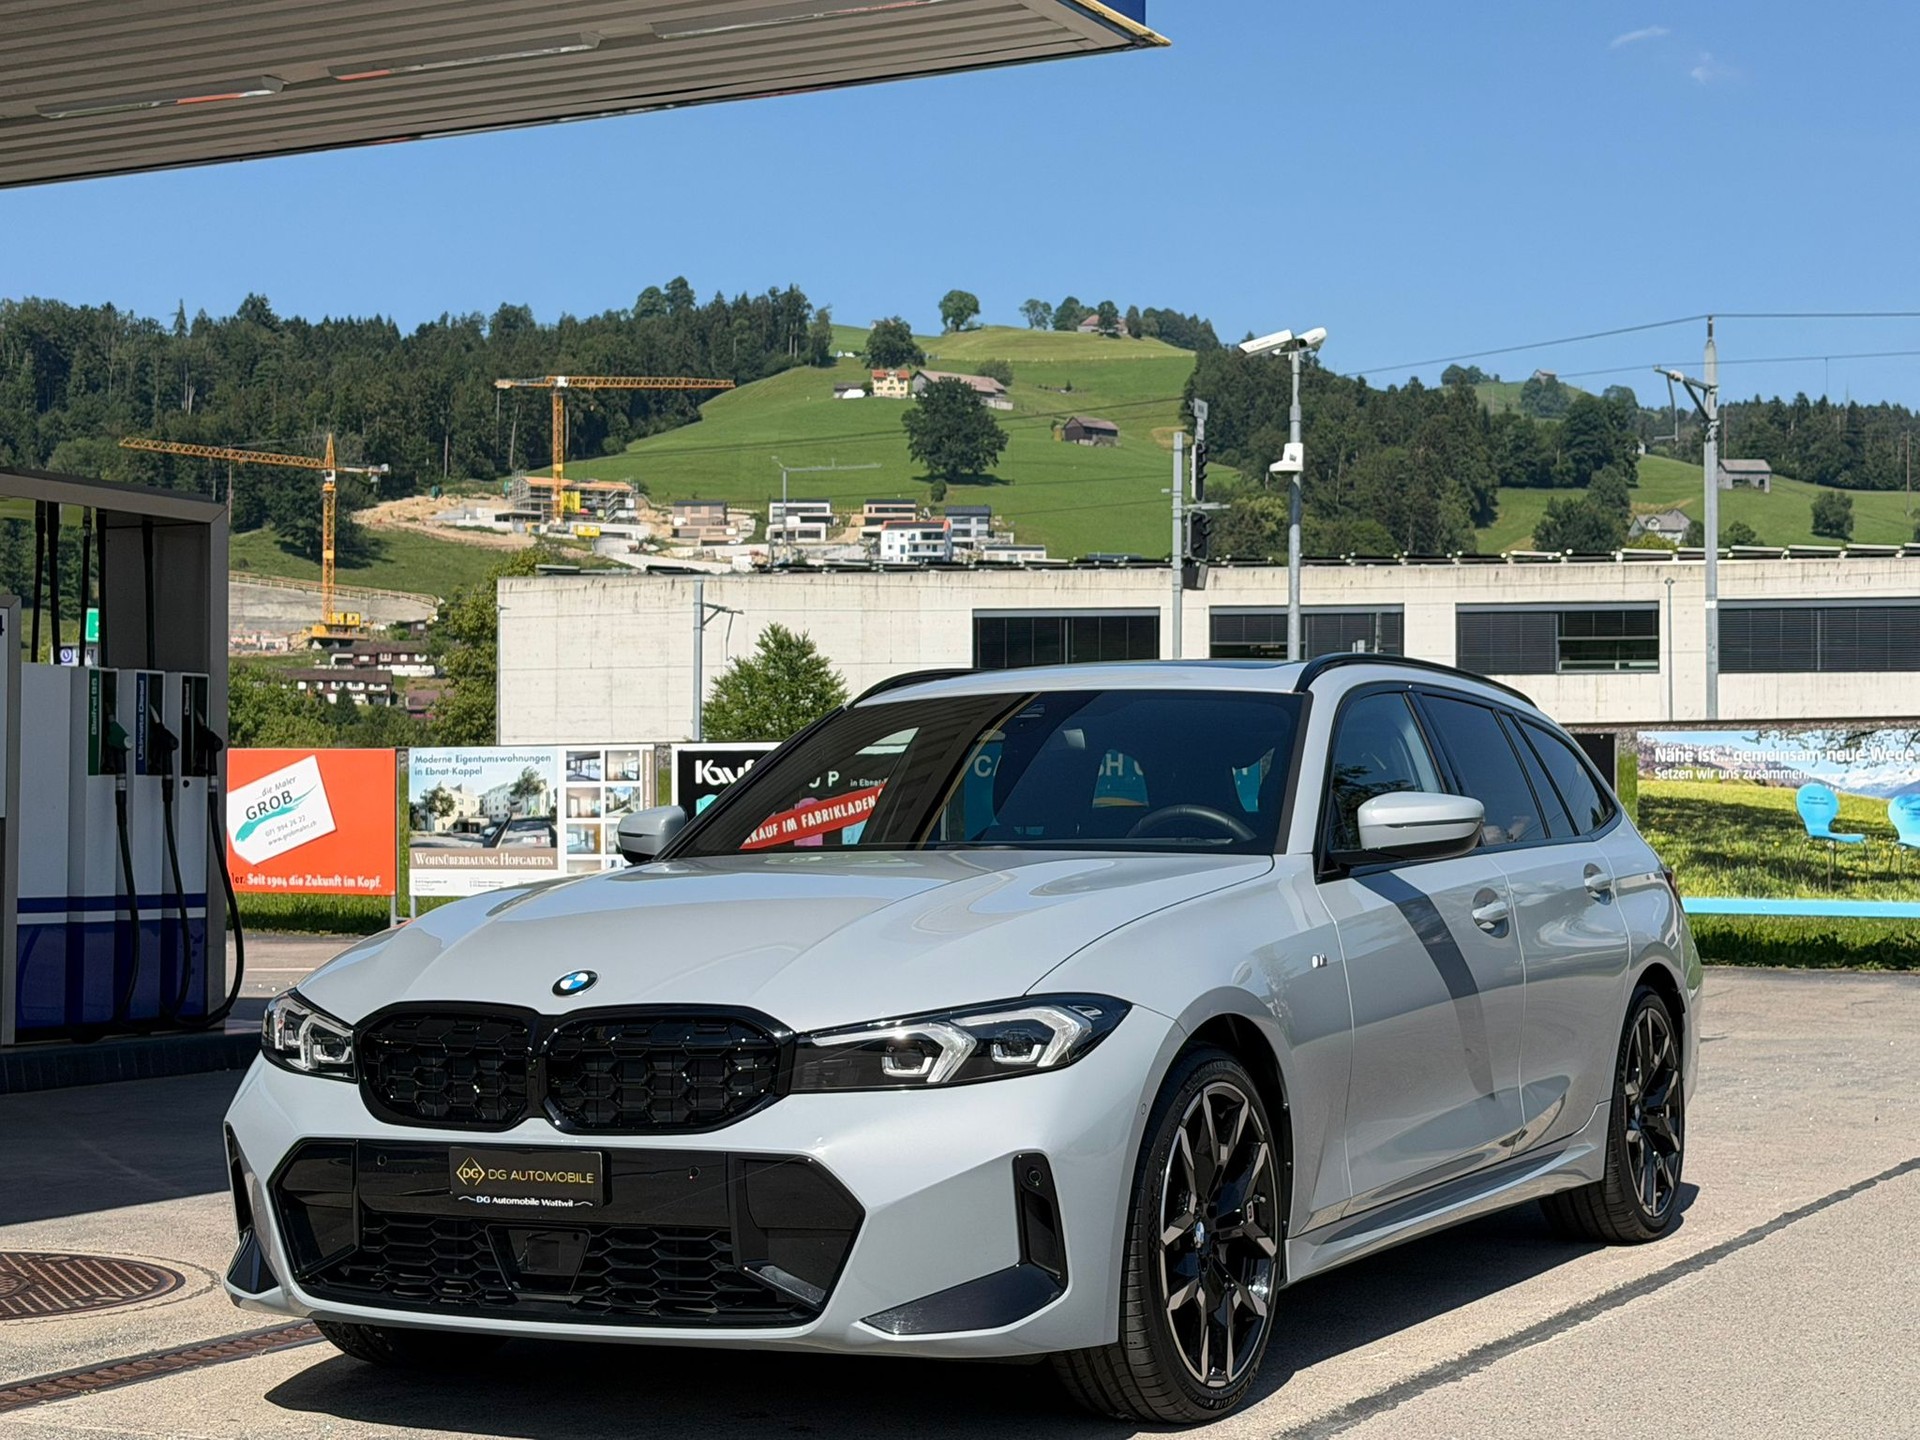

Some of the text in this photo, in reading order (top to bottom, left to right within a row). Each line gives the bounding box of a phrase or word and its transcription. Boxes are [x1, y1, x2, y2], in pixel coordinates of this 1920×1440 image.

[137, 680, 145, 713] Diesel
[415, 753, 552, 765] Moderne Eigentumswohnungen
[1654, 747, 1694, 763] Nähe
[1733, 748, 1822, 767] gemeinsam
[1826, 746, 1866, 763] neue
[1871, 746, 1915, 765] Wege
[414, 767, 423, 776] in
[1654, 767, 1694, 780] Setzen
[1696, 767, 1715, 780] wir
[1718, 768, 1740, 780] uns
[274, 776, 297, 791] Maler
[850, 779, 858, 787] in
[245, 790, 293, 821] GROB
[781, 817, 798, 833] IM
[801, 795, 876, 829] FABRIKLADEN
[500, 852, 554, 866] HOFGARTEN
[247, 873, 265, 886] Seit
[289, 874, 303, 886] die
[305, 874, 342, 887] Zukunft
[343, 875, 356, 887] im
[462, 1167, 595, 1184] DG DG AUTOMOBILE
[476, 1195, 574, 1208] DG Automobile Wattwil
